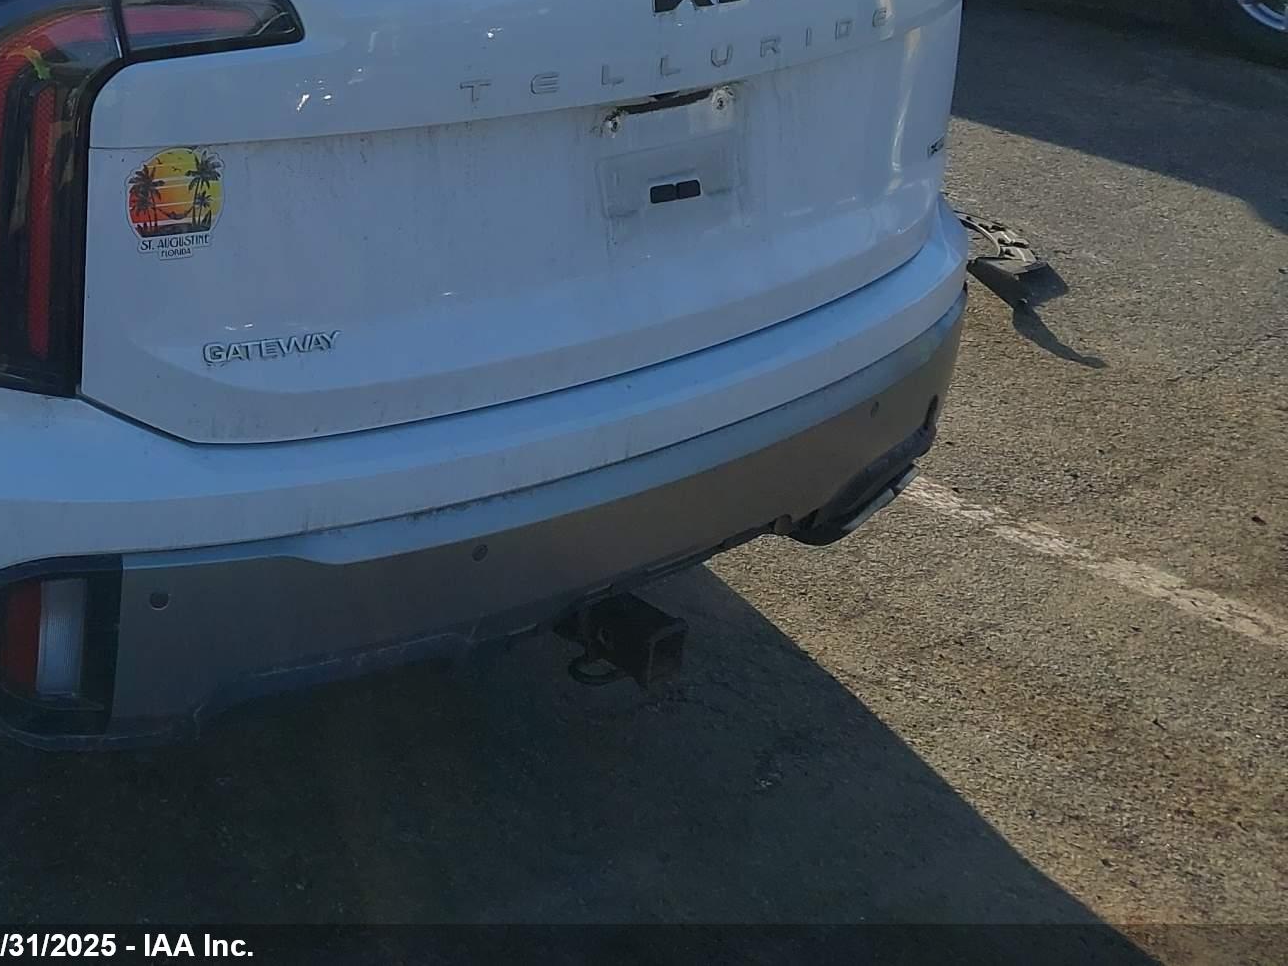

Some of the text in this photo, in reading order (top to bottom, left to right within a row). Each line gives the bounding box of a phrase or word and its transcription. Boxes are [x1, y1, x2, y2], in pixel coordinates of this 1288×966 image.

[459, 7, 889, 103] TELLURIDE
[140, 234, 210, 251] ST. AUGUSTINE
[203, 330, 341, 364] GATEWAY
